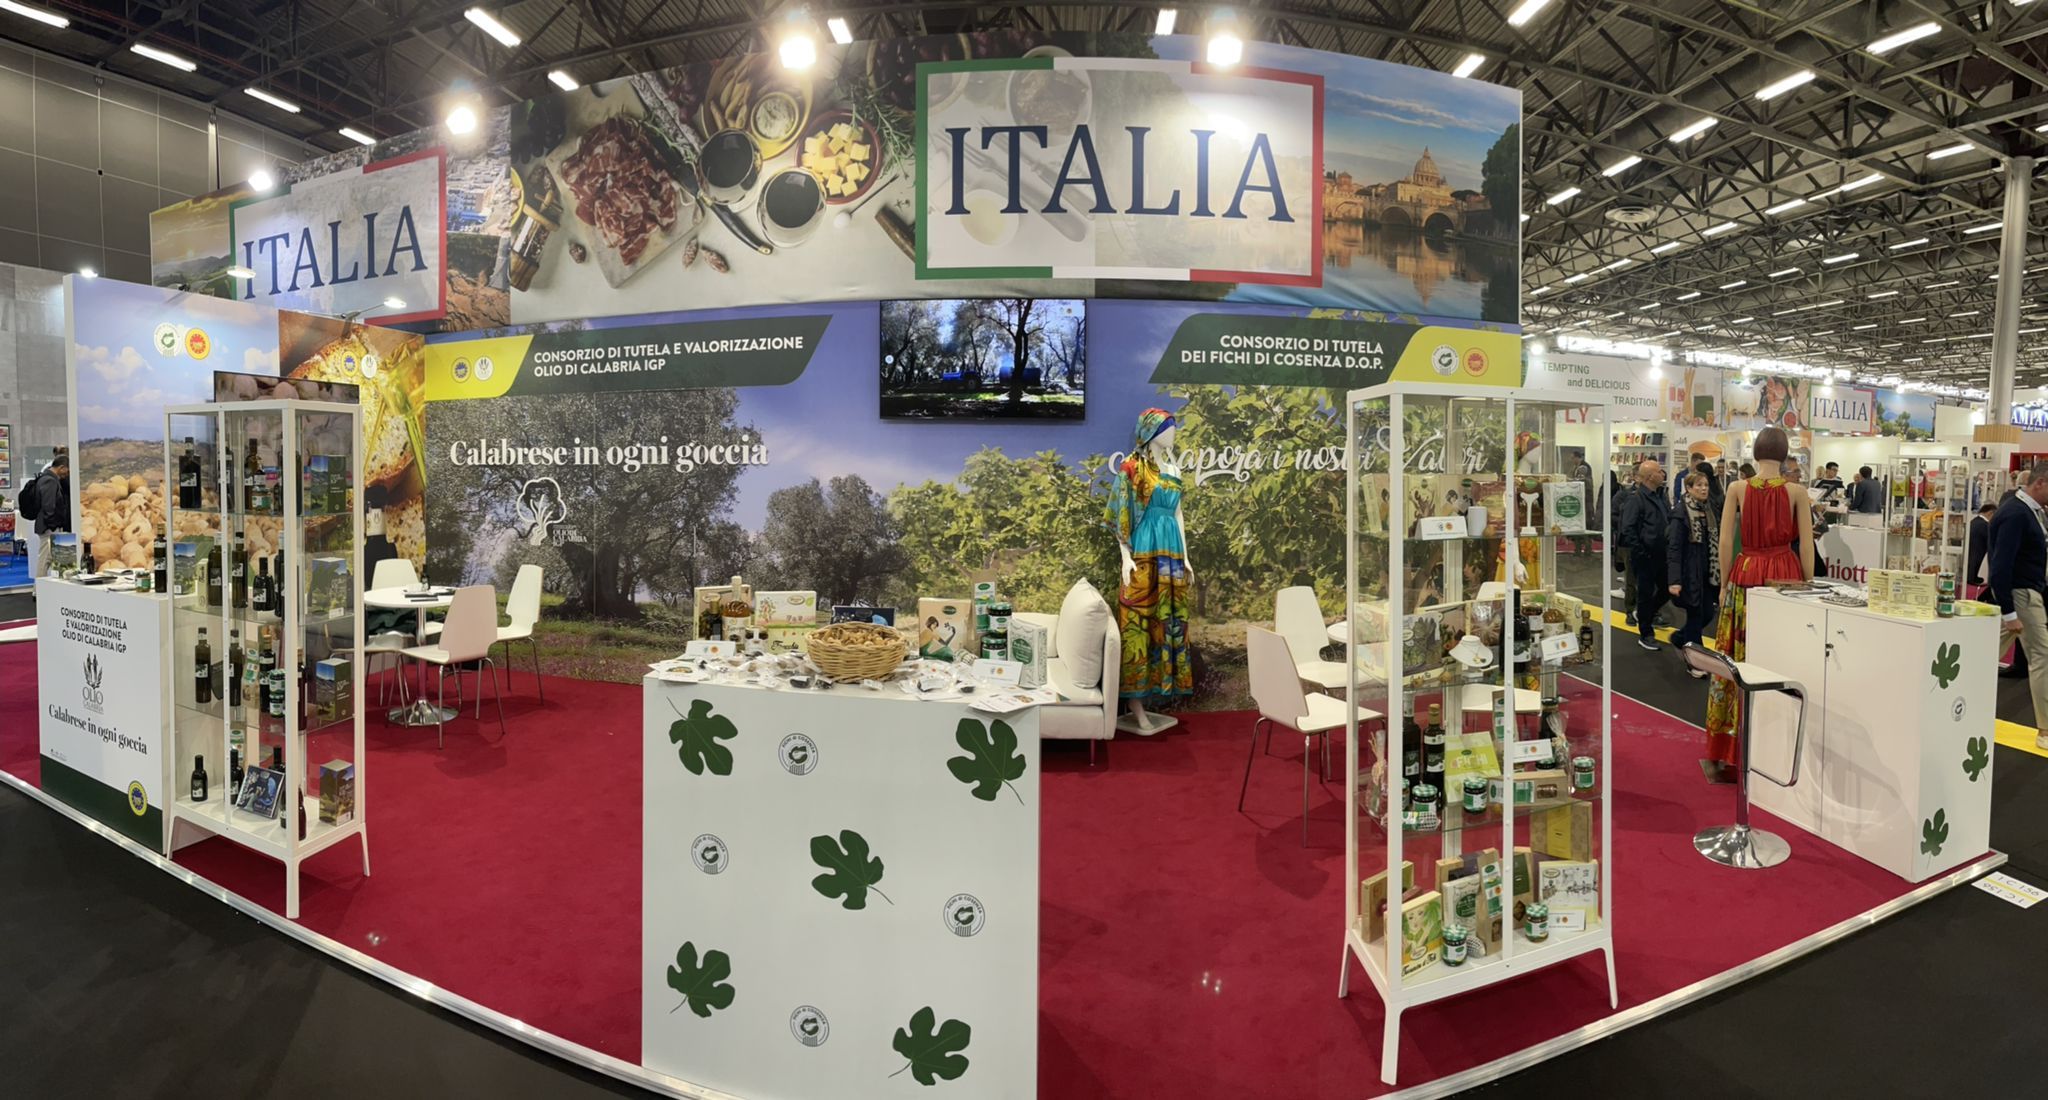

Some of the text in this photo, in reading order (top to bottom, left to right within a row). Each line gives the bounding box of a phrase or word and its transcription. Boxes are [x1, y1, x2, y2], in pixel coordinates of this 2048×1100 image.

[944, 123, 1295, 223] ITALIA
[242, 204, 428, 300] ITALIA
[534, 336, 804, 364] CONSORZIO DI TUTELA E VALORIZZAZIONE
[1220, 335, 1384, 355] CONSORZIO DI TUTELA
[534, 358, 666, 377] OLIO DI CALABRIA IGP
[1181, 350, 1384, 370] DEI FICHI DI COSENZA D.O.P.
[1543, 361, 1590, 375] TEMPTING
[1567, 378, 1631, 391] and DELICIOUS
[1613, 395, 1658, 407] TRADITION
[1813, 397, 1869, 422] ITALIA
[449, 434, 769, 473] Calabrese in ogni goccia
[1295, 444, 1377, 471] nosti
[60, 607, 127, 630] CONSORZIO DI TUTELA
[66, 619, 122, 641] E VALORIZZAZIONE
[62, 629, 127, 653] OLIO DI CALABRIA IGP
[83, 686, 104, 705] OLIO
[48, 704, 148, 755] Calabrese in ogni goccia
